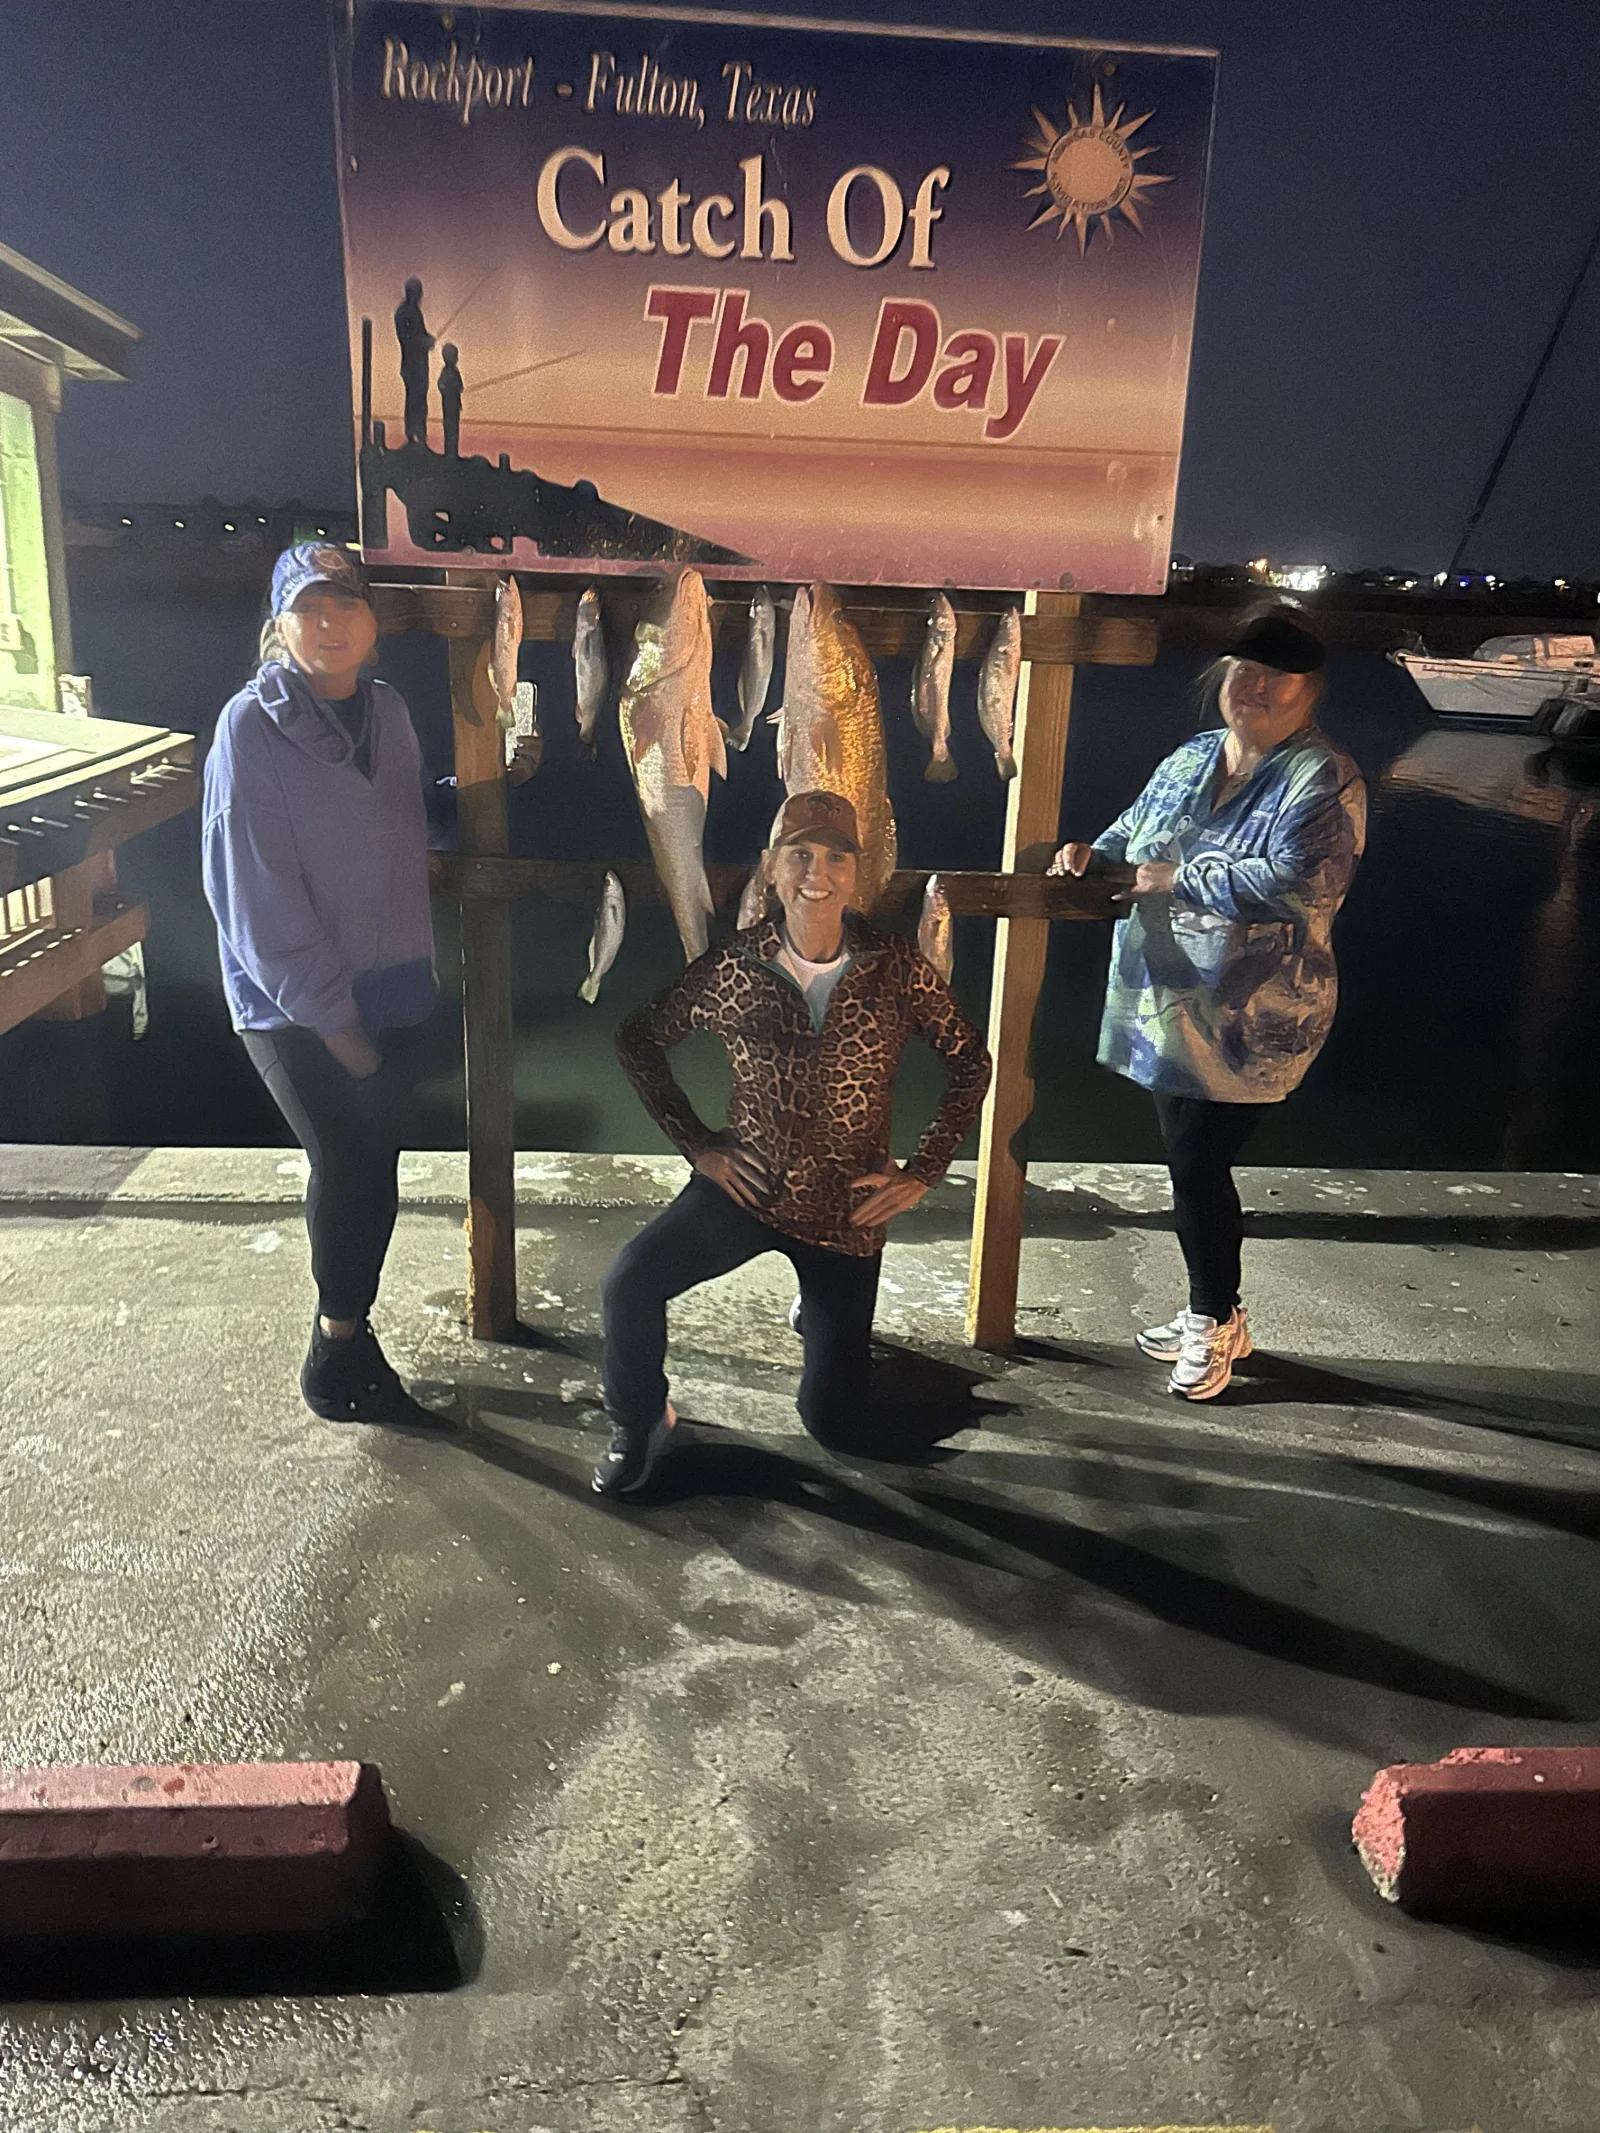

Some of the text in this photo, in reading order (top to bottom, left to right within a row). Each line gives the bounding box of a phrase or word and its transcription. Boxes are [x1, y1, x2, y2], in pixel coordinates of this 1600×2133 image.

[383, 37, 534, 127] Rockport
[584, 52, 705, 130] Fulton,
[722, 60, 817, 127] Texas
[537, 146, 951, 268] Catch Of
[642, 284, 1067, 440] The Day
